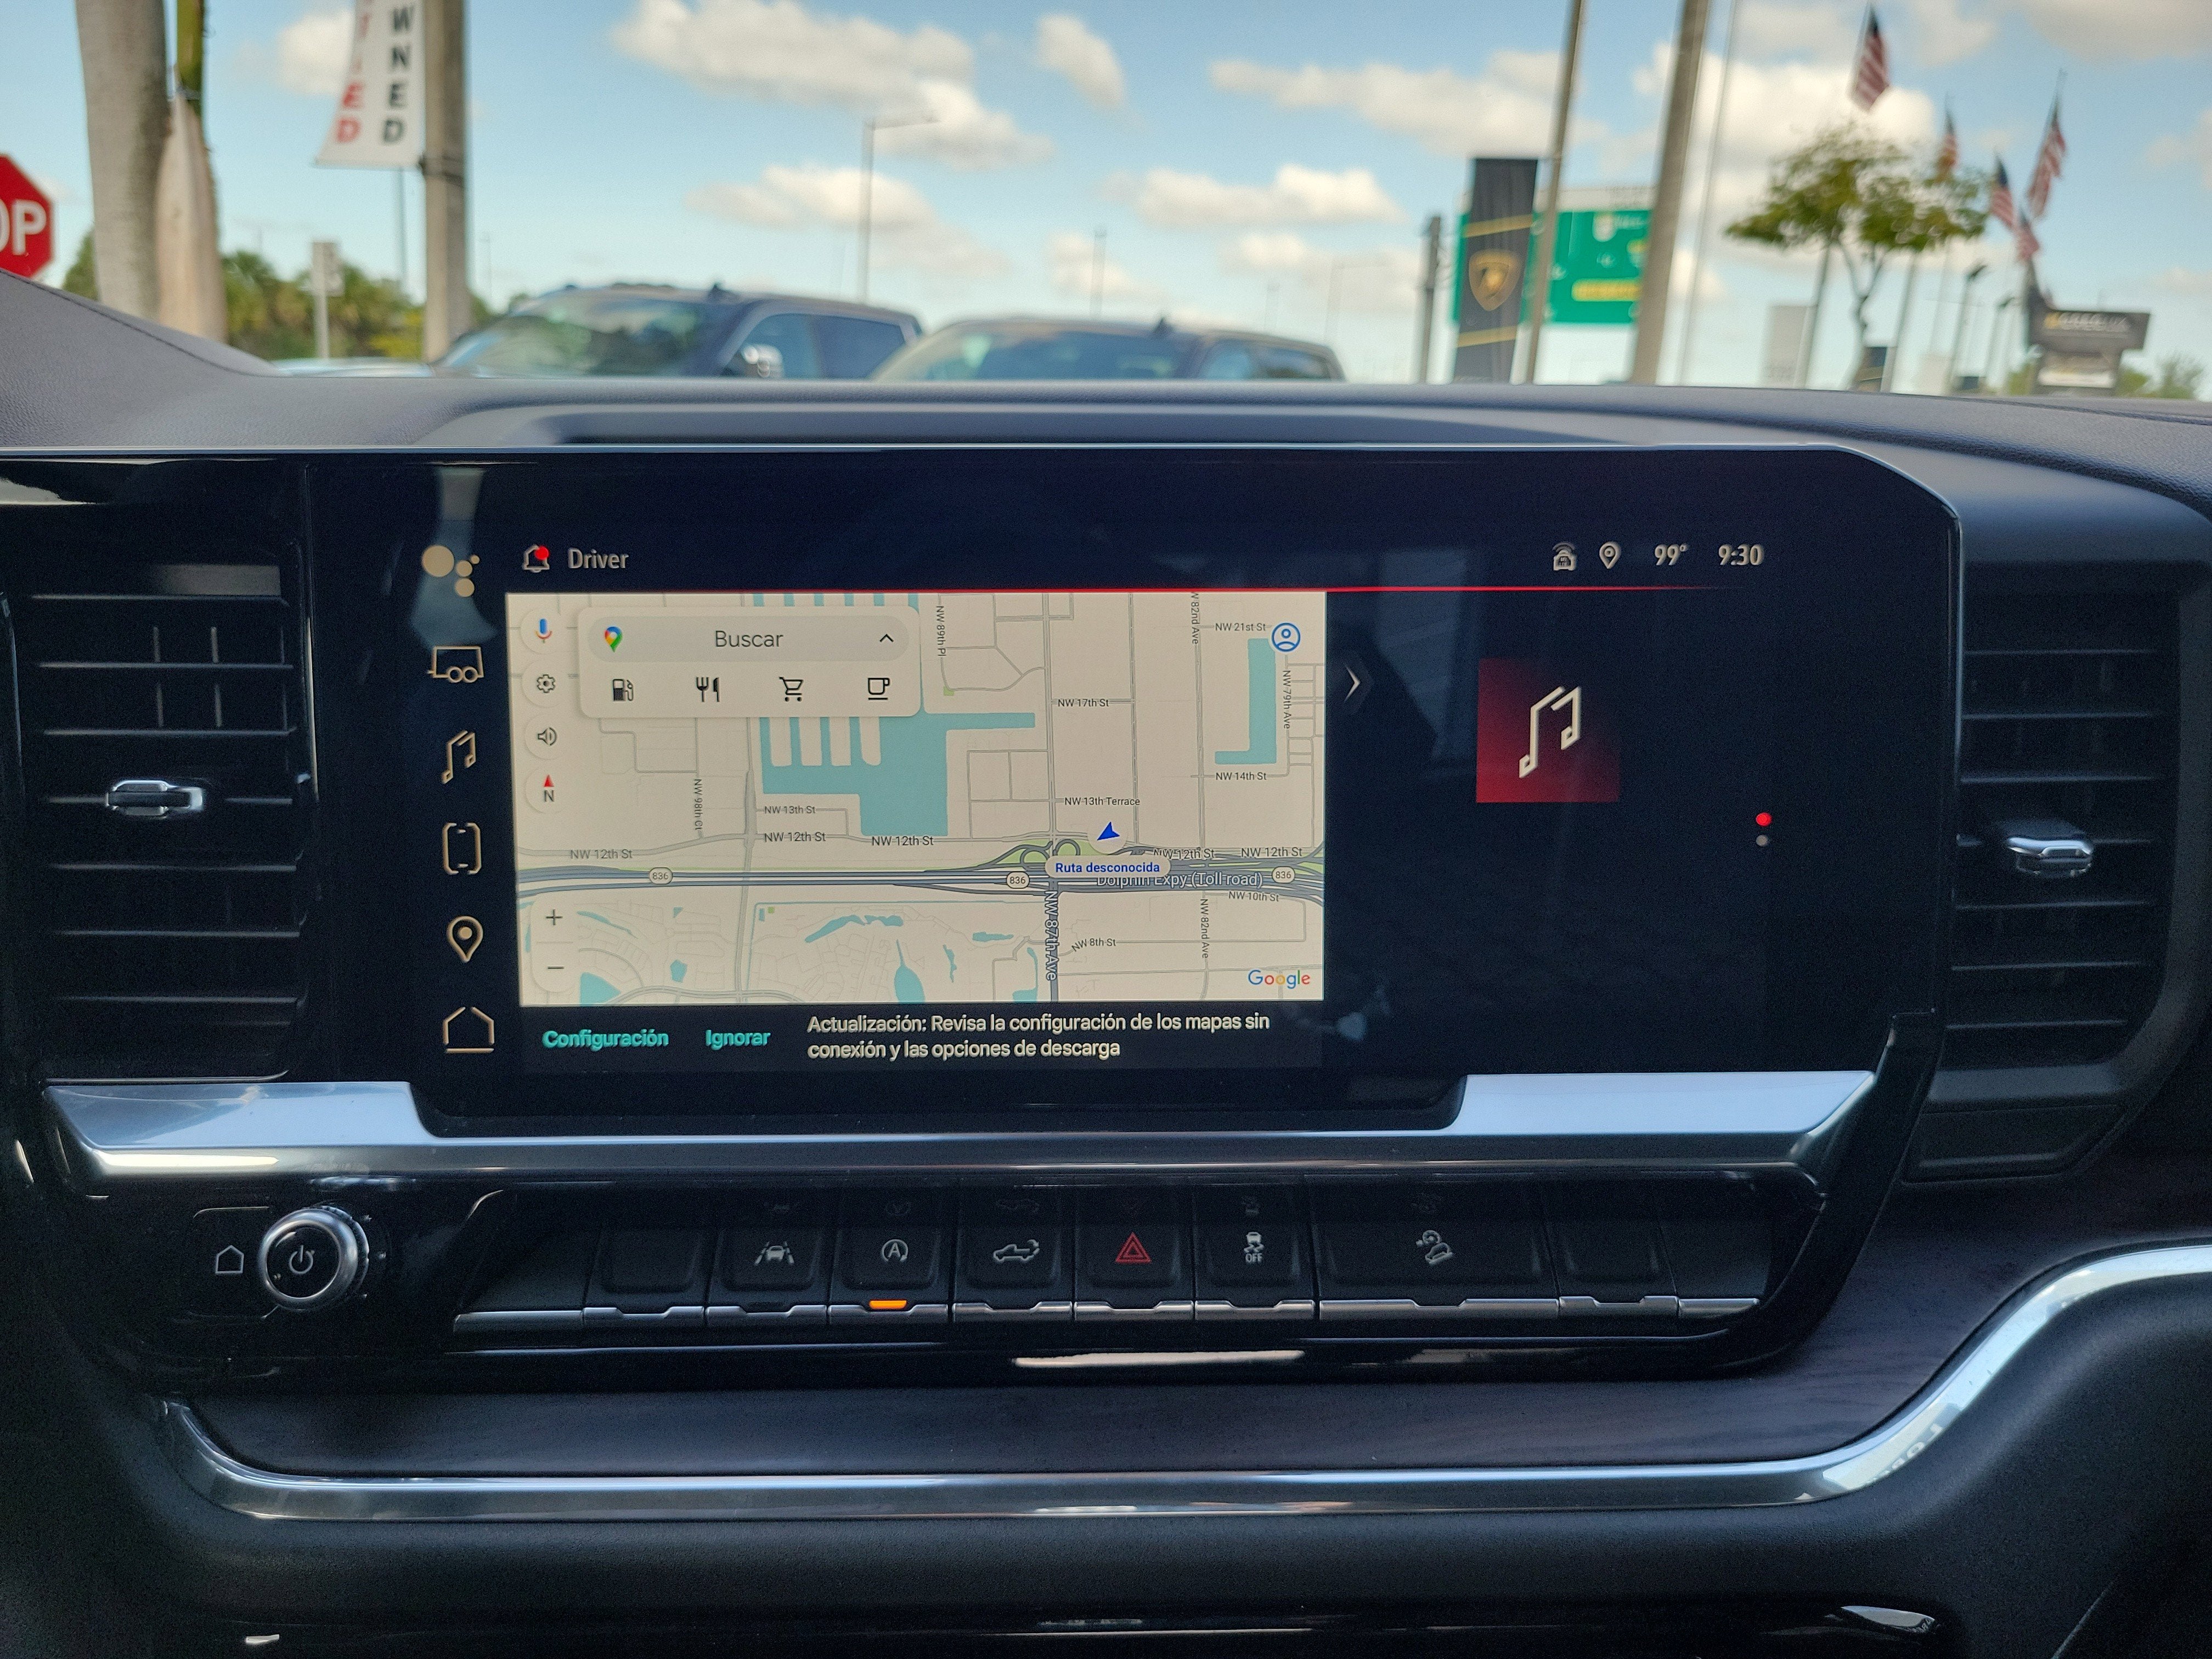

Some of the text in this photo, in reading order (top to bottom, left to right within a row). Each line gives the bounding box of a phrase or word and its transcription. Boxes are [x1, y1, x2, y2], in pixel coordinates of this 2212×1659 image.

[568, 548, 629, 569] Driver
[1655, 543, 1689, 566] 99°
[1718, 544, 1764, 566] 9:30
[1190, 602, 1200, 624] 82nd
[936, 606, 946, 657] NW 89th Pl
[1192, 627, 1200, 644] Ave
[1215, 623, 1266, 631] NW 21st St
[715, 630, 784, 648] Buscar
[1058, 698, 1109, 707] NW 17th St
[1283, 670, 1291, 729] NW 79th Ave
[1234, 772, 1255, 780] 14th
[543, 790, 555, 802] N
[694, 779, 703, 830] NW 98th Ct
[764, 805, 816, 814] NW 13th St
[764, 832, 826, 842] NW 12th St
[872, 836, 934, 845] NW 12th St
[571, 849, 633, 859] NW 12th St
[1177, 848, 1201, 859] 12th
[1203, 848, 1214, 858] St
[1241, 847, 1302, 857] NW 12th St
[1056, 862, 1160, 872] Ruta desconocida
[652, 872, 669, 880] 836
[1154, 877, 1188, 889] Expy
[1191, 871, 1222, 888] (Toll
[1226, 872, 1263, 889] road)
[1228, 891, 1280, 902] NW 10th St
[1045, 890, 1059, 980] NW 87th Ave
[1200, 899, 1210, 958] NW 82nd Ave
[1071, 938, 1117, 952] NW 8th St
[1248, 969, 1311, 989] Google
[806, 1012, 1270, 1035] Actualización: Revisa la configuración de los mapas sin
[542, 1029, 669, 1051] Configuración
[706, 1030, 771, 1050] Ignorar
[807, 1039, 1120, 1062] conexión y las opciones de descarga
[1245, 1252, 1263, 1263] OFF
